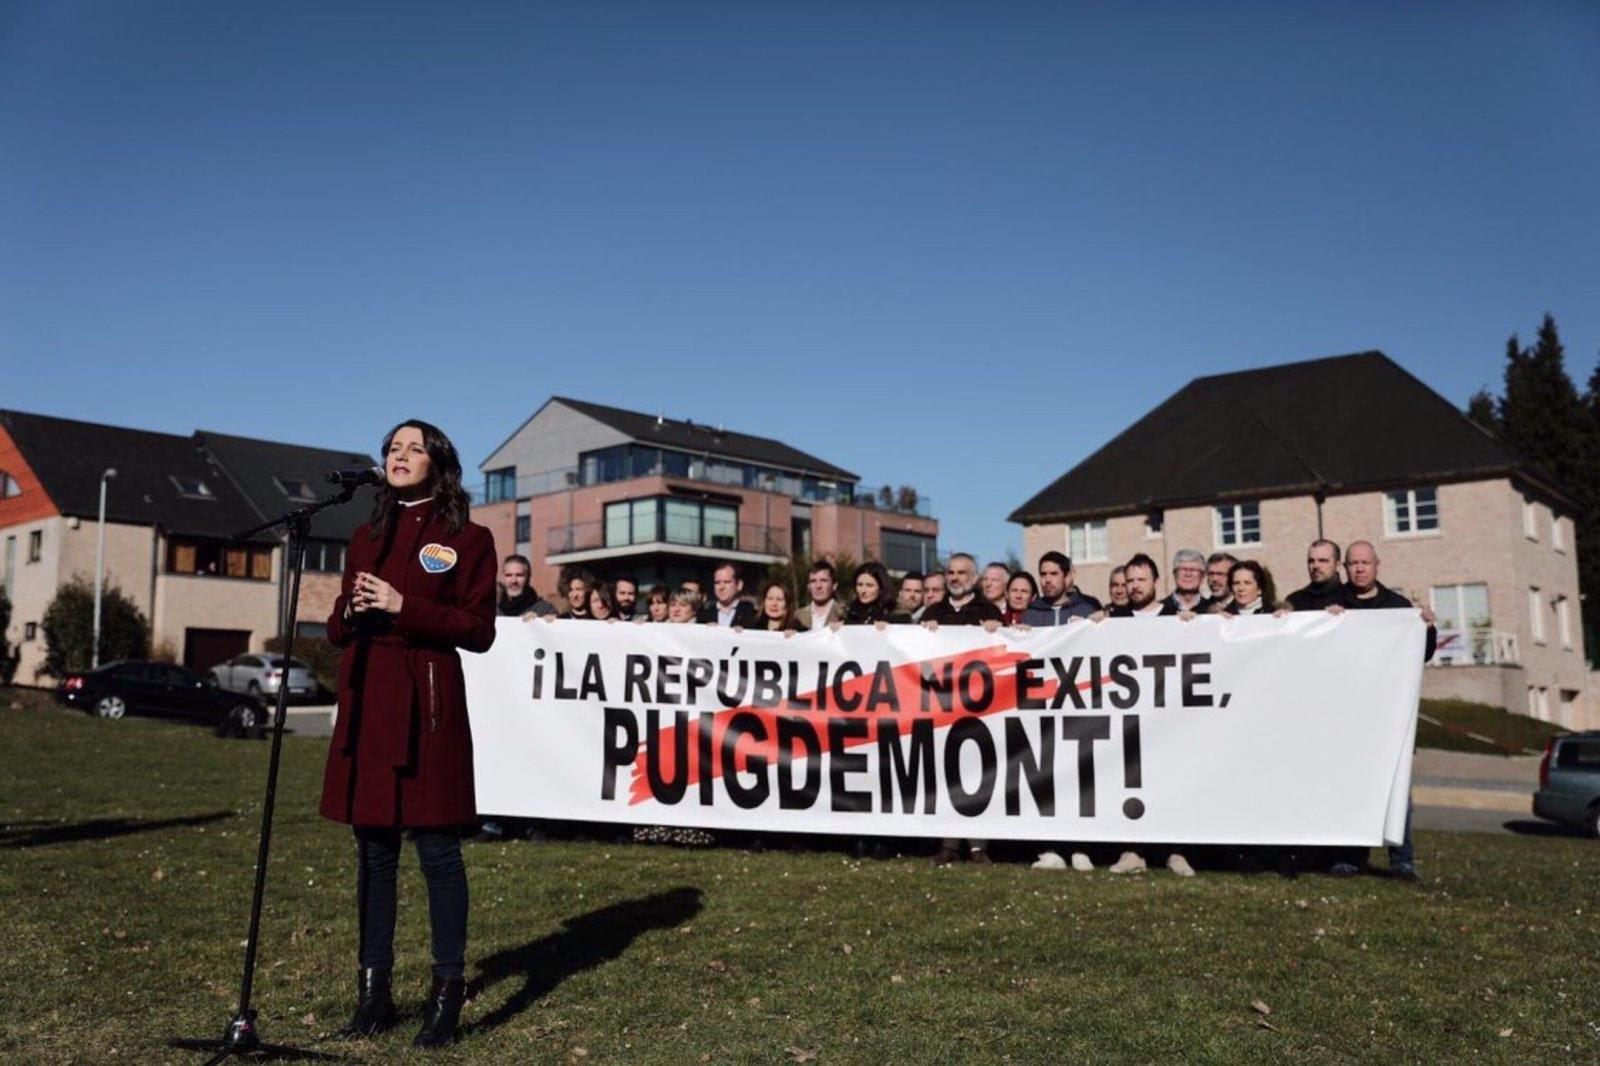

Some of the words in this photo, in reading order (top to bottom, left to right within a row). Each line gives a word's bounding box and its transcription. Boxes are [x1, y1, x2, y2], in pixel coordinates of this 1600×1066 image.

[624, 646, 899, 713] REPÚBLICA
[920, 659, 995, 713] NO
[1015, 652, 1232, 711] EXISTE,
[601, 707, 1146, 820] PUIGDEMONT!
